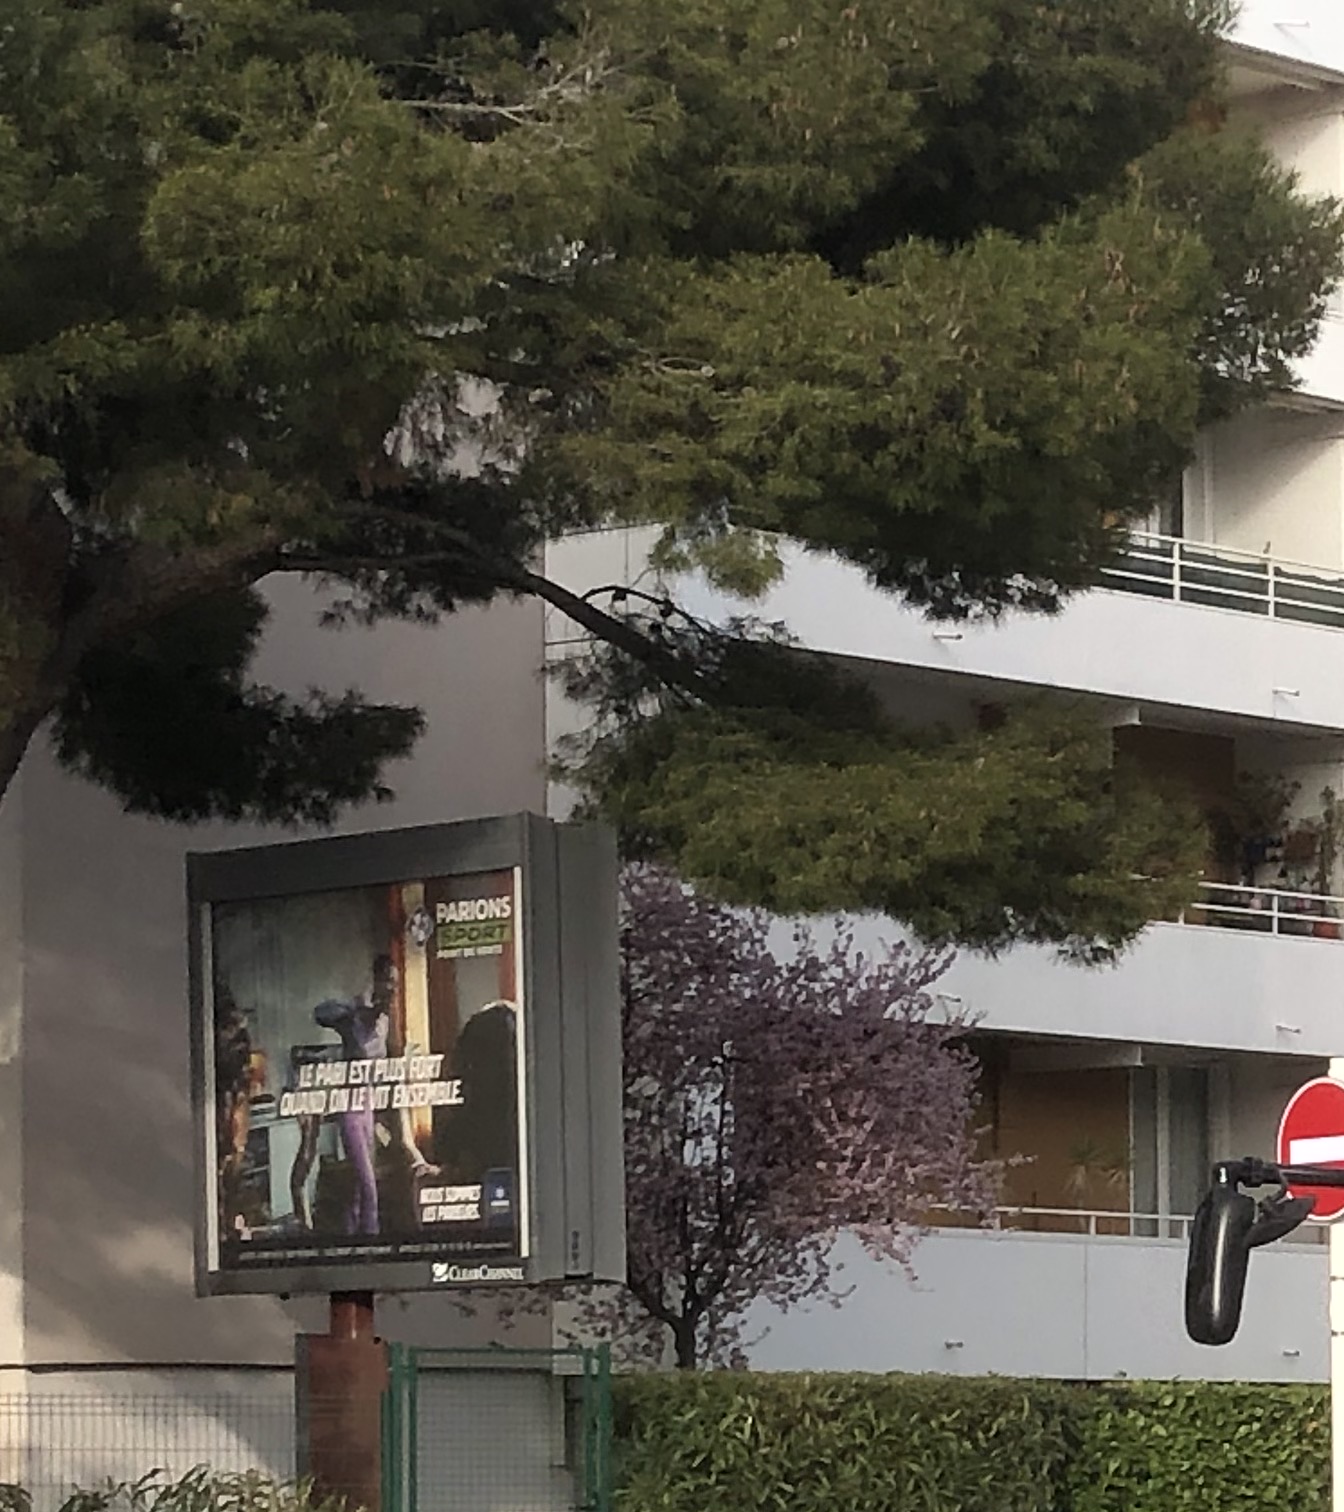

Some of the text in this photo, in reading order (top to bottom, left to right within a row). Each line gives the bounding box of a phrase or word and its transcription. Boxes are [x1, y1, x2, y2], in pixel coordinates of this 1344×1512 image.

[436, 895, 512, 924] PARIONS
[440, 924, 507, 944] SPORT
[349, 1058, 374, 1084] EST
